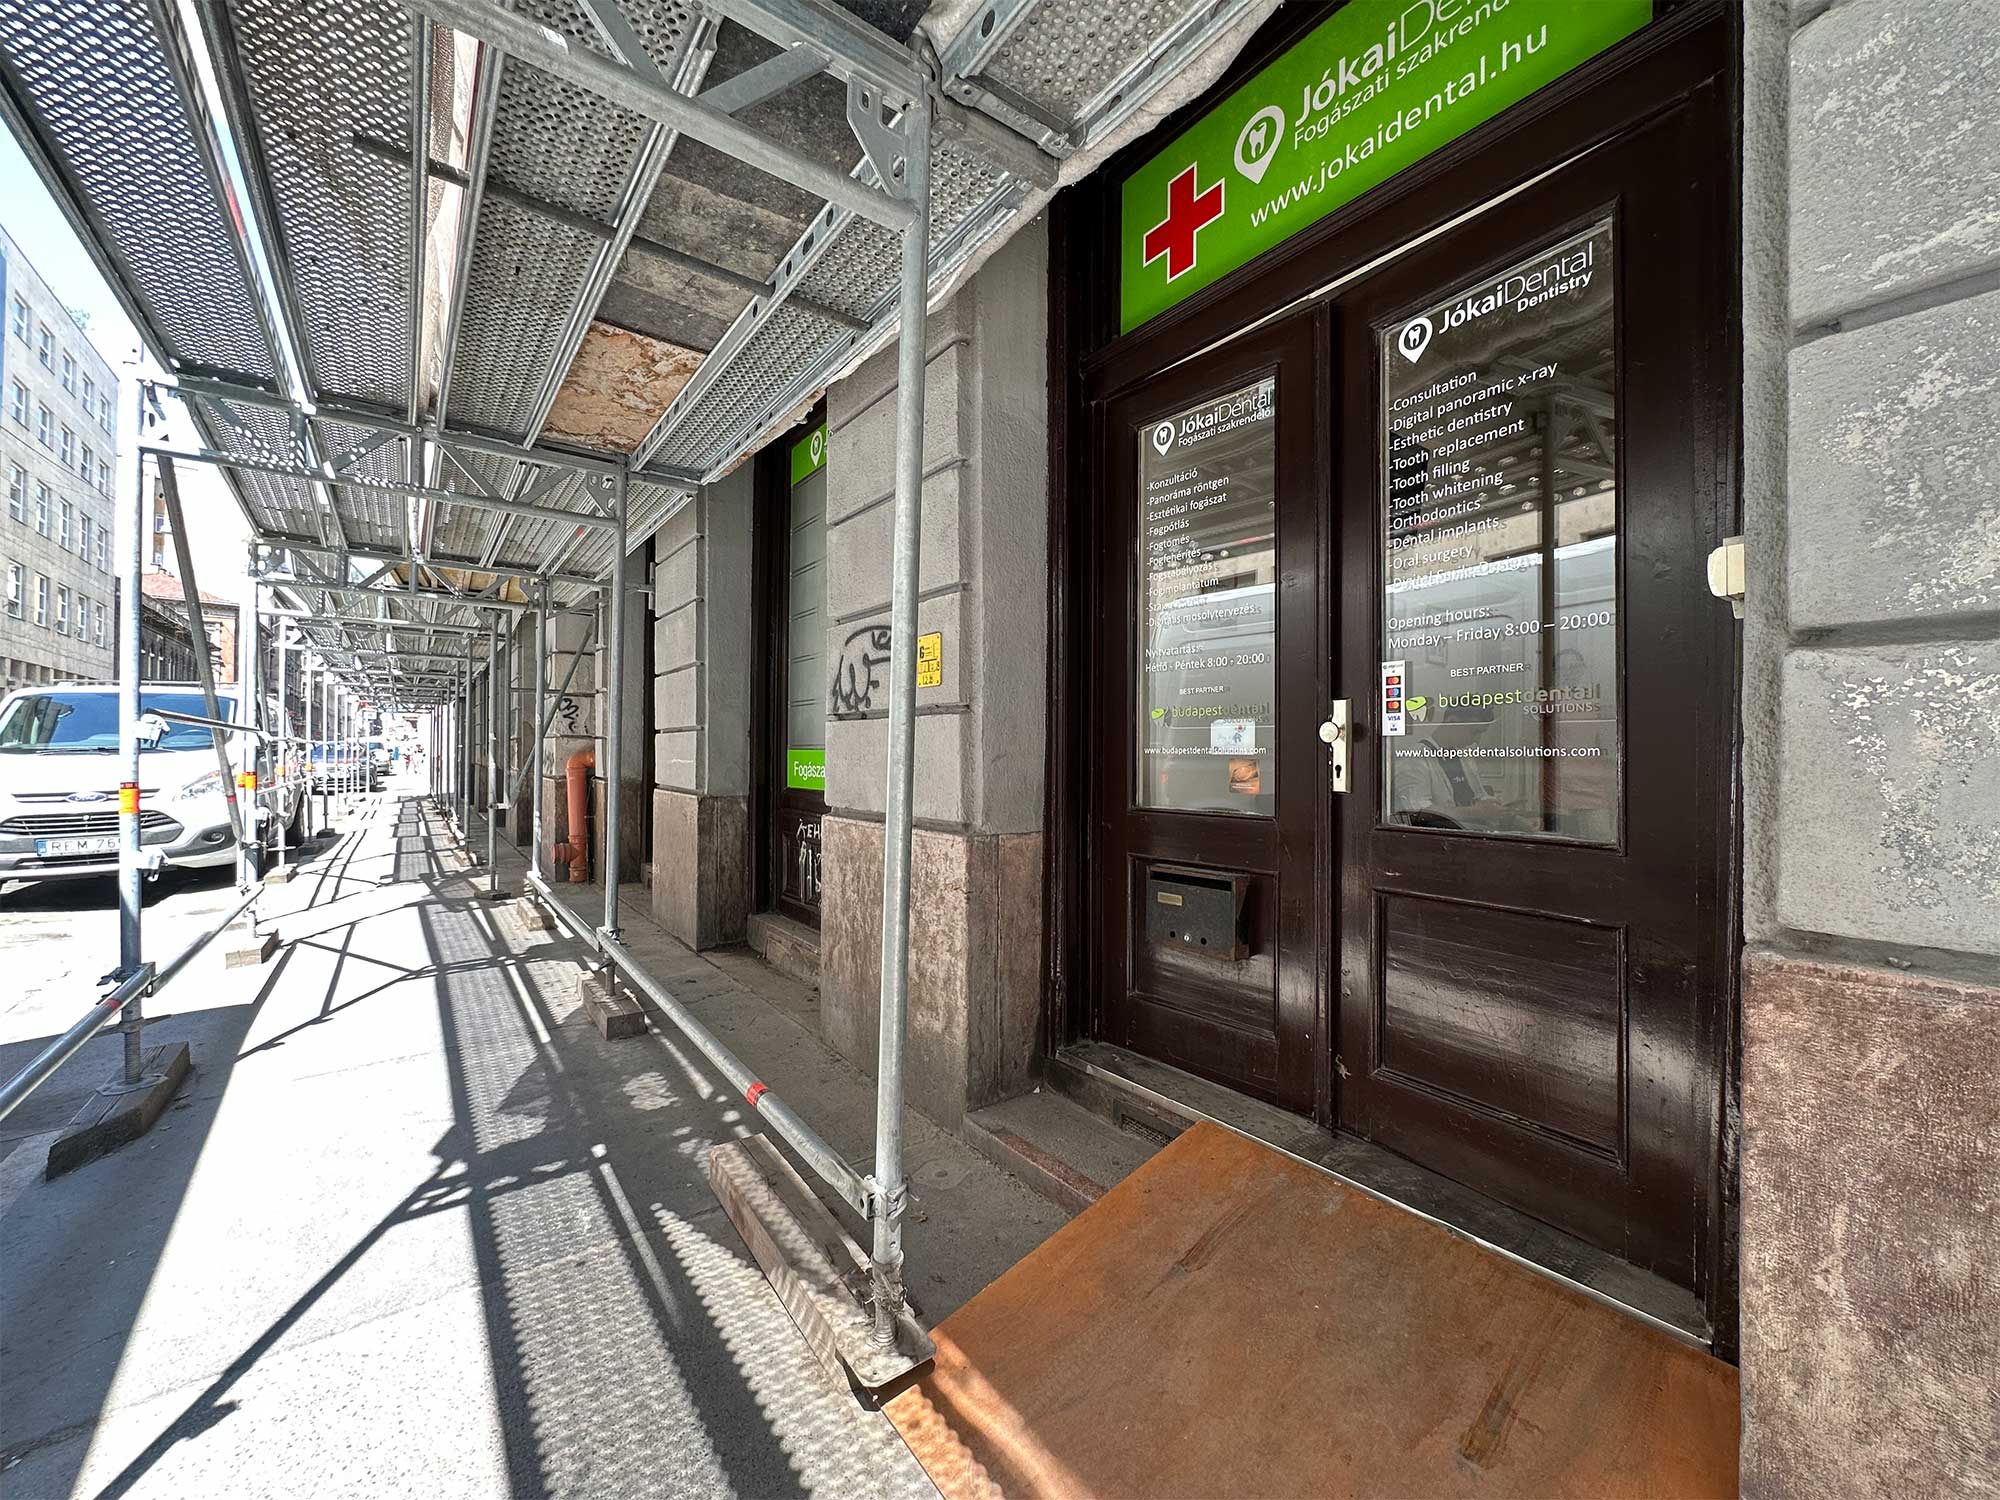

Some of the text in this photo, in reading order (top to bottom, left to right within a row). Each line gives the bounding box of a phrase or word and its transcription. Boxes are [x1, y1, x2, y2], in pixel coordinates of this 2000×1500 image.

[1295, 0, 1473, 128] JókaiDe
[1294, 68, 1390, 150] Fogászati
[1250, 24, 1547, 229] www.jokaidental.hu
[1439, 241, 1593, 334] JókaiDental
[1517, 271, 1593, 312] Dentistry
[1389, 370, 1477, 411] -Consultation
[1389, 362, 1558, 432] -Digital panoramic x-ray
[1178, 406, 1271, 447] Fogászati szakrendélő
[1179, 388, 1271, 437] JókaiDental
[1389, 401, 1513, 451] -Esthetic dentistry
[1389, 418, 1525, 471] -Tooth replacement
[1146, 467, 1198, 491] -Konzultáció
[1389, 459, 1471, 491] -Tooth filling
[1389, 470, 1504, 511] -Tooth whitening
[1146, 476, 1230, 506] -Panoráma röntgen
[1146, 493, 1227, 521] -Esztétikai fogászat
[1389, 499, 1481, 530] -Orthodontics
[1146, 518, 1190, 536] -Fogpótlás
[1389, 515, 1500, 550] -Dental implants
[1389, 543, 1473, 570] -Oral surgery
[1183, 602, 1255, 622] mosolytervezés
[1388, 606, 1491, 632] Opening hours:
[1388, 632, 1441, 650] Monday
[1456, 626, 1501, 644] Friday
[1504, 619, 1540, 636] 8:00
[1560, 610, 1611, 631] 20:00
[1145, 661, 1168, 673] Hétfő
[1175, 659, 1205, 671] Péntek
[1207, 656, 1228, 667] 8:00
[1237, 652, 1265, 665] 20:00
[1450, 662, 1524, 677] BEST PARTNER
[1179, 685, 1224, 695] BEST PARTNER
[1438, 682, 1597, 709] budapestdental
[1523, 702, 1593, 714] SOLUTIONS
[1395, 745, 1601, 759] www.budapestdentalsolutions.com
[96, 838, 121, 850] 76
